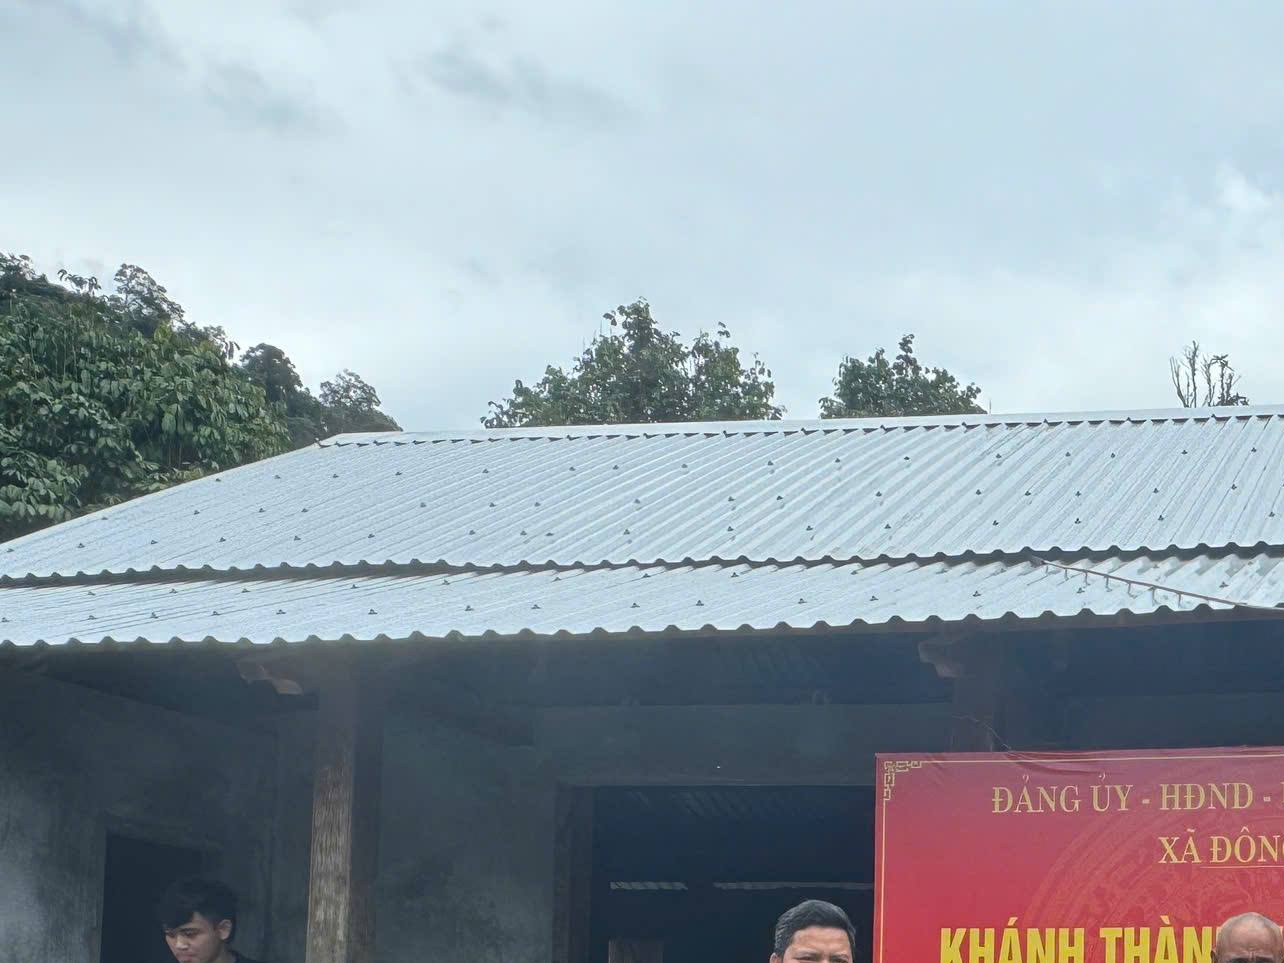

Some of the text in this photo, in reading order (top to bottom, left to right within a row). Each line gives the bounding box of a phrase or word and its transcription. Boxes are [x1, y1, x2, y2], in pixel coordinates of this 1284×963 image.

[991, 774, 1082, 813] ĐẢNG
[1090, 773, 1134, 812] ỦY
[1159, 782, 1253, 810] HĐND
[1158, 828, 1201, 864] XÃ
